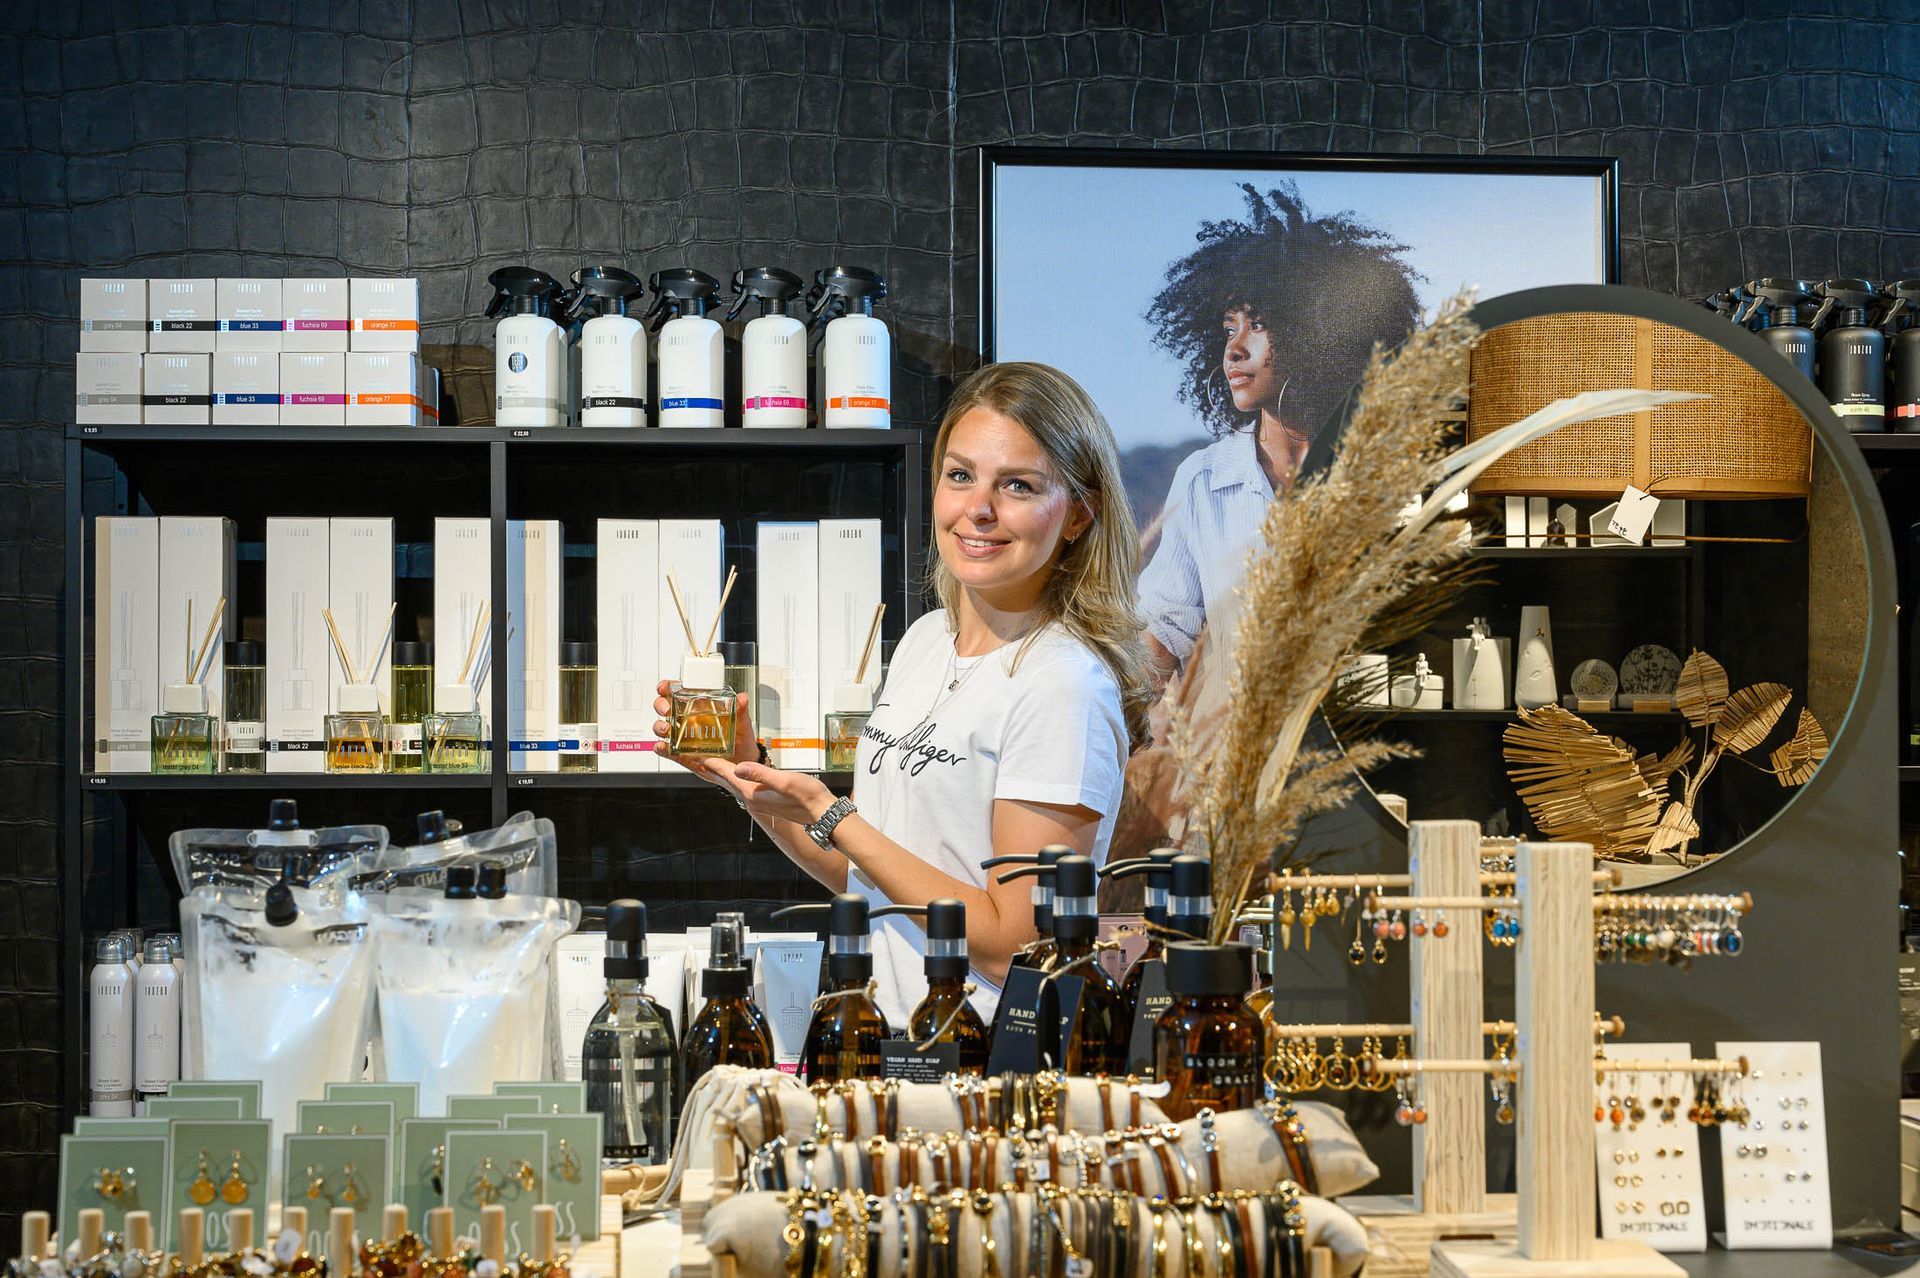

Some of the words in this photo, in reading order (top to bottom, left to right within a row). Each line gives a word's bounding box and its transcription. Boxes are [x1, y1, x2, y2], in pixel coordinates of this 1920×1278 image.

[783, 399, 790, 407] 69
[862, 724, 897, 774] mmy
[1146, 997, 1172, 1005] HAND
[1009, 1008, 1036, 1019] HAND
[1186, 1058, 1237, 1067] BLOOM
